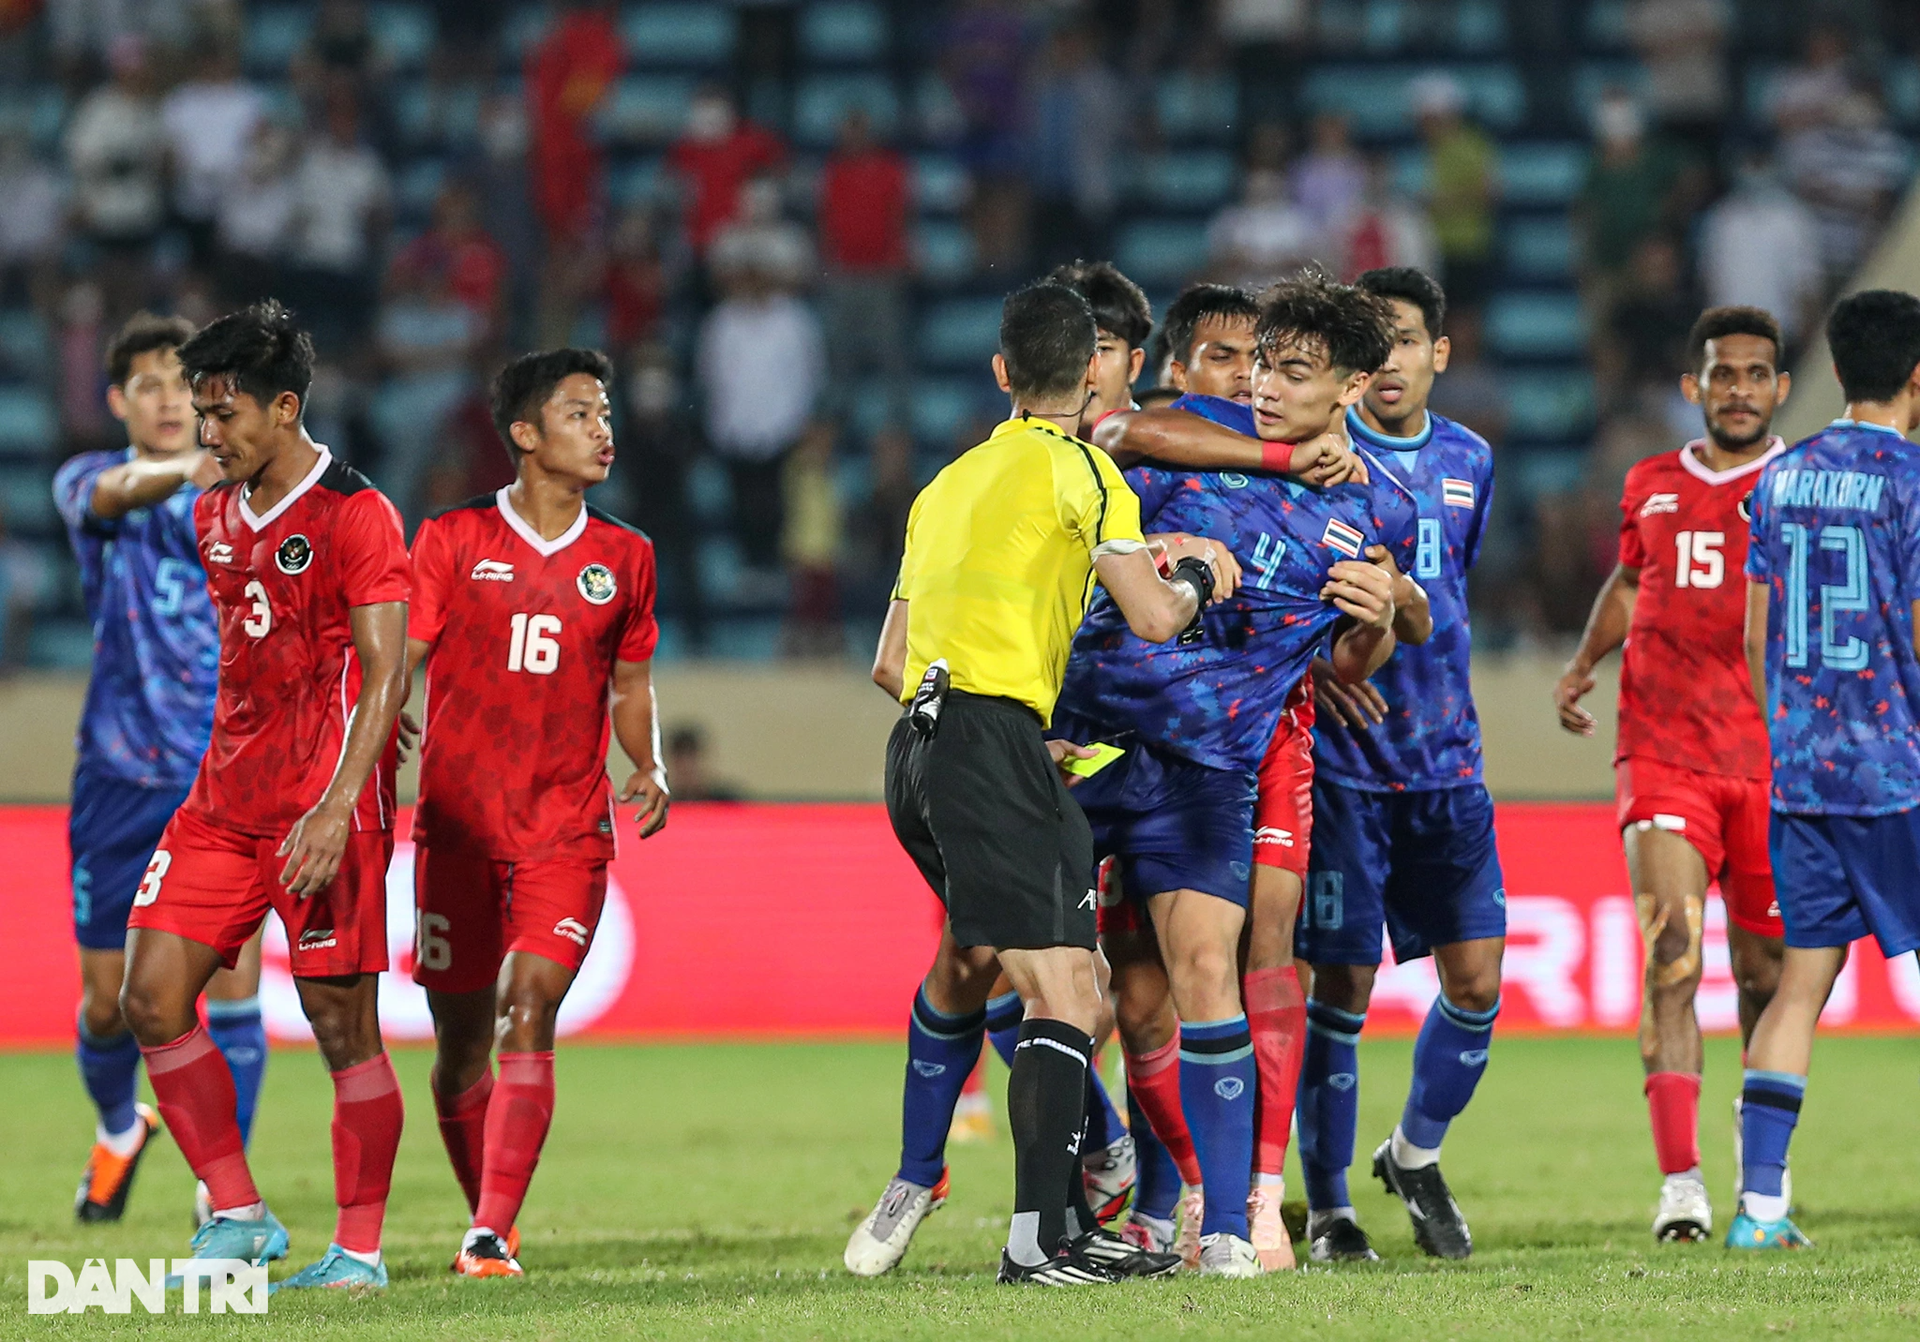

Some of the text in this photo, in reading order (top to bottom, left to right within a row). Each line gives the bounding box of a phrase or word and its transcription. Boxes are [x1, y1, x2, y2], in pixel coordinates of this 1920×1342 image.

[1250, 532, 1287, 589] 4
[1415, 518, 1441, 579] 8
[1675, 531, 1725, 588] 15
[153, 557, 184, 616] 5
[244, 580, 272, 638] 3
[1781, 522, 1870, 671] 12
[507, 612, 562, 675] 16
[133, 850, 171, 908] 3
